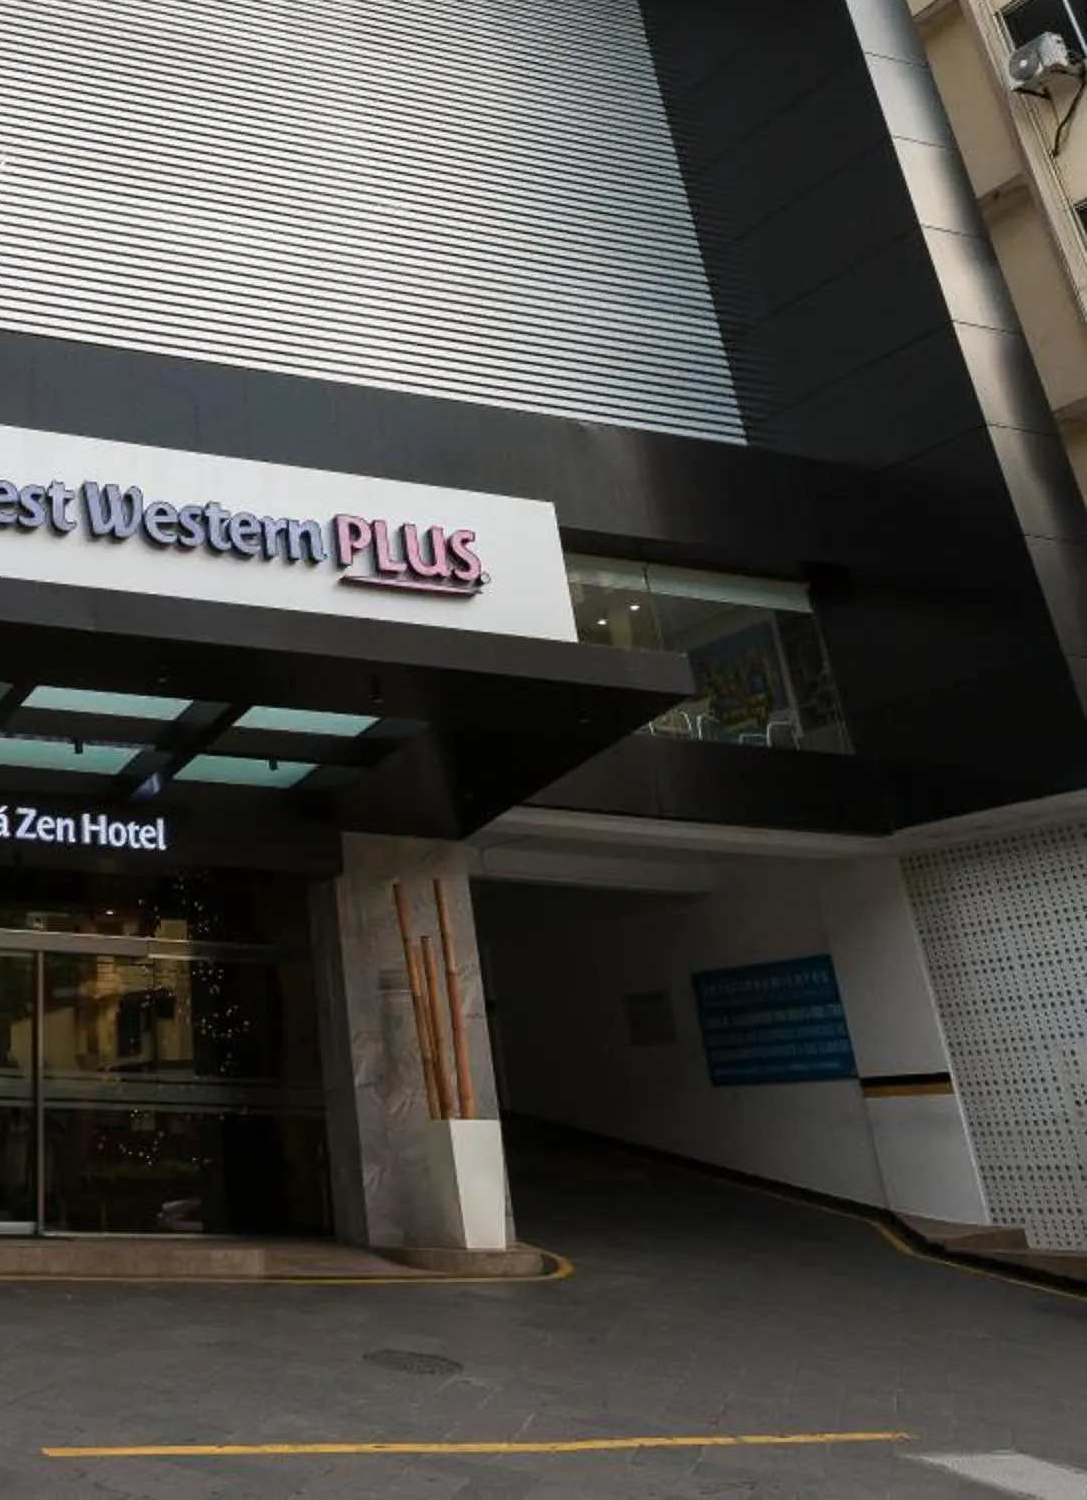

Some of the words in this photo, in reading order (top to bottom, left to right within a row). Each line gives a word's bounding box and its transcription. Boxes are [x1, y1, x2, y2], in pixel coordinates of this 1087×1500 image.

[83, 481, 327, 562] Western
[333, 513, 482, 584] PLUS
[15, 807, 76, 843] Zen
[81, 813, 167, 850] Hotel
